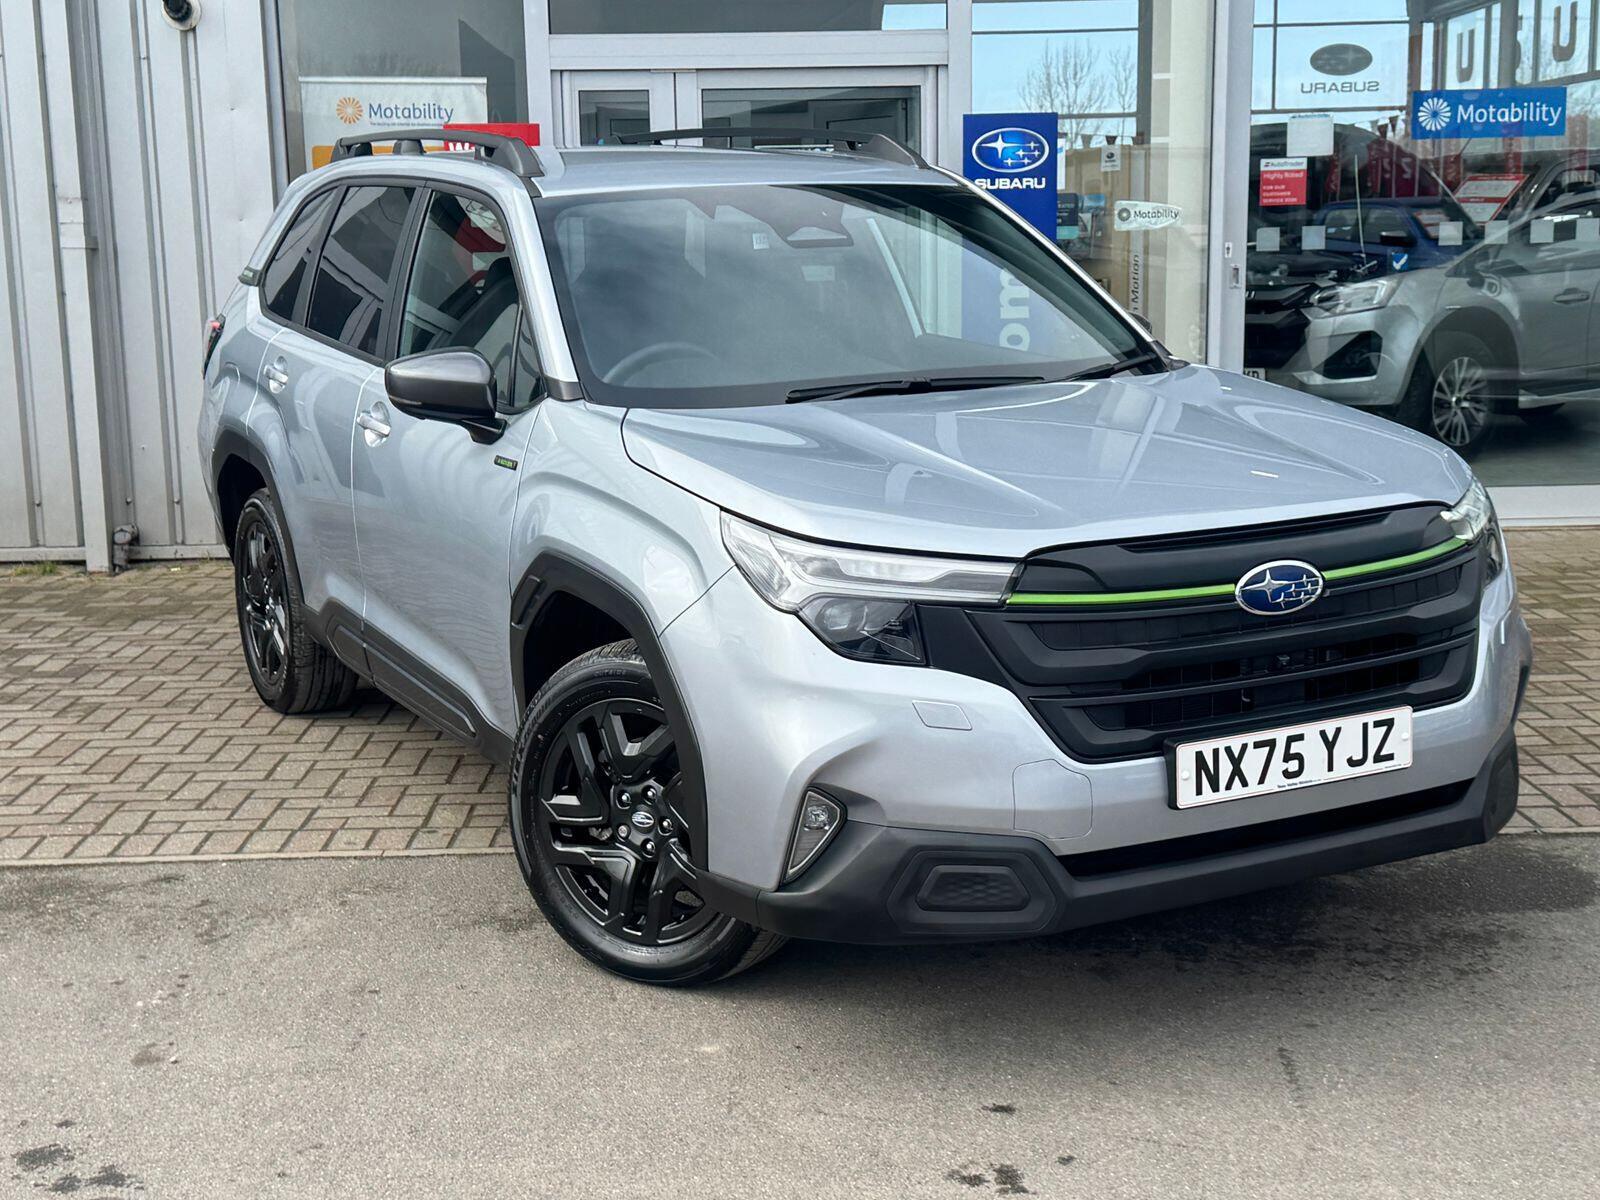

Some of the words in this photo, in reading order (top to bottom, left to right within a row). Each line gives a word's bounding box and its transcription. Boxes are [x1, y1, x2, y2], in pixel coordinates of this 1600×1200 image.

[369, 102, 454, 123] Motability
[1457, 102, 1562, 127] Motability
[974, 177, 1046, 190] SUBARU
[1133, 208, 1180, 220] Motability
[1131, 254, 1140, 304] Motion
[1195, 733, 1305, 796] NX75
[1319, 717, 1395, 773] YJZ
